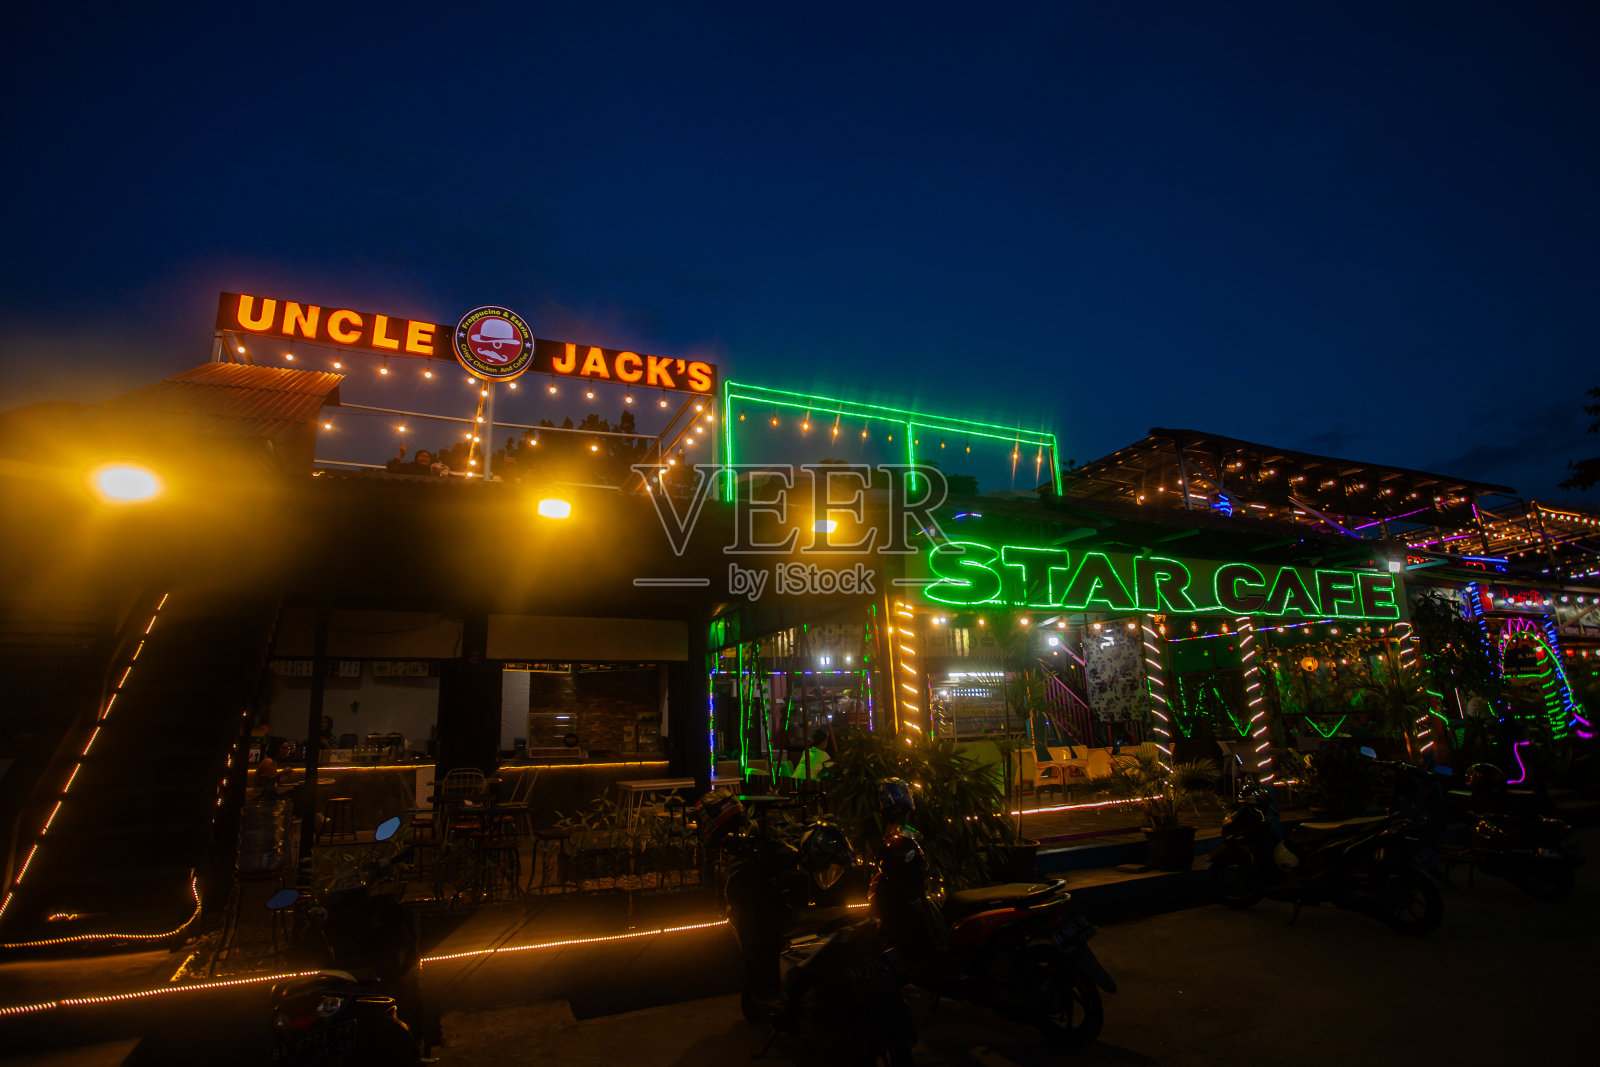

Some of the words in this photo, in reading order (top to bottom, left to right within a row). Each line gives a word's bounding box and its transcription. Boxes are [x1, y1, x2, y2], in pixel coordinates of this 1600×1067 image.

[236, 294, 437, 356] UNCLE
[461, 308, 501, 330] Frappucino
[461, 343, 474, 361] Crispy
[473, 360, 498, 373] Chicken
[500, 365, 514, 373] And
[552, 342, 712, 392] JACK'S
[924, 541, 1197, 613] STAR
[1214, 562, 1400, 620] CAFE
